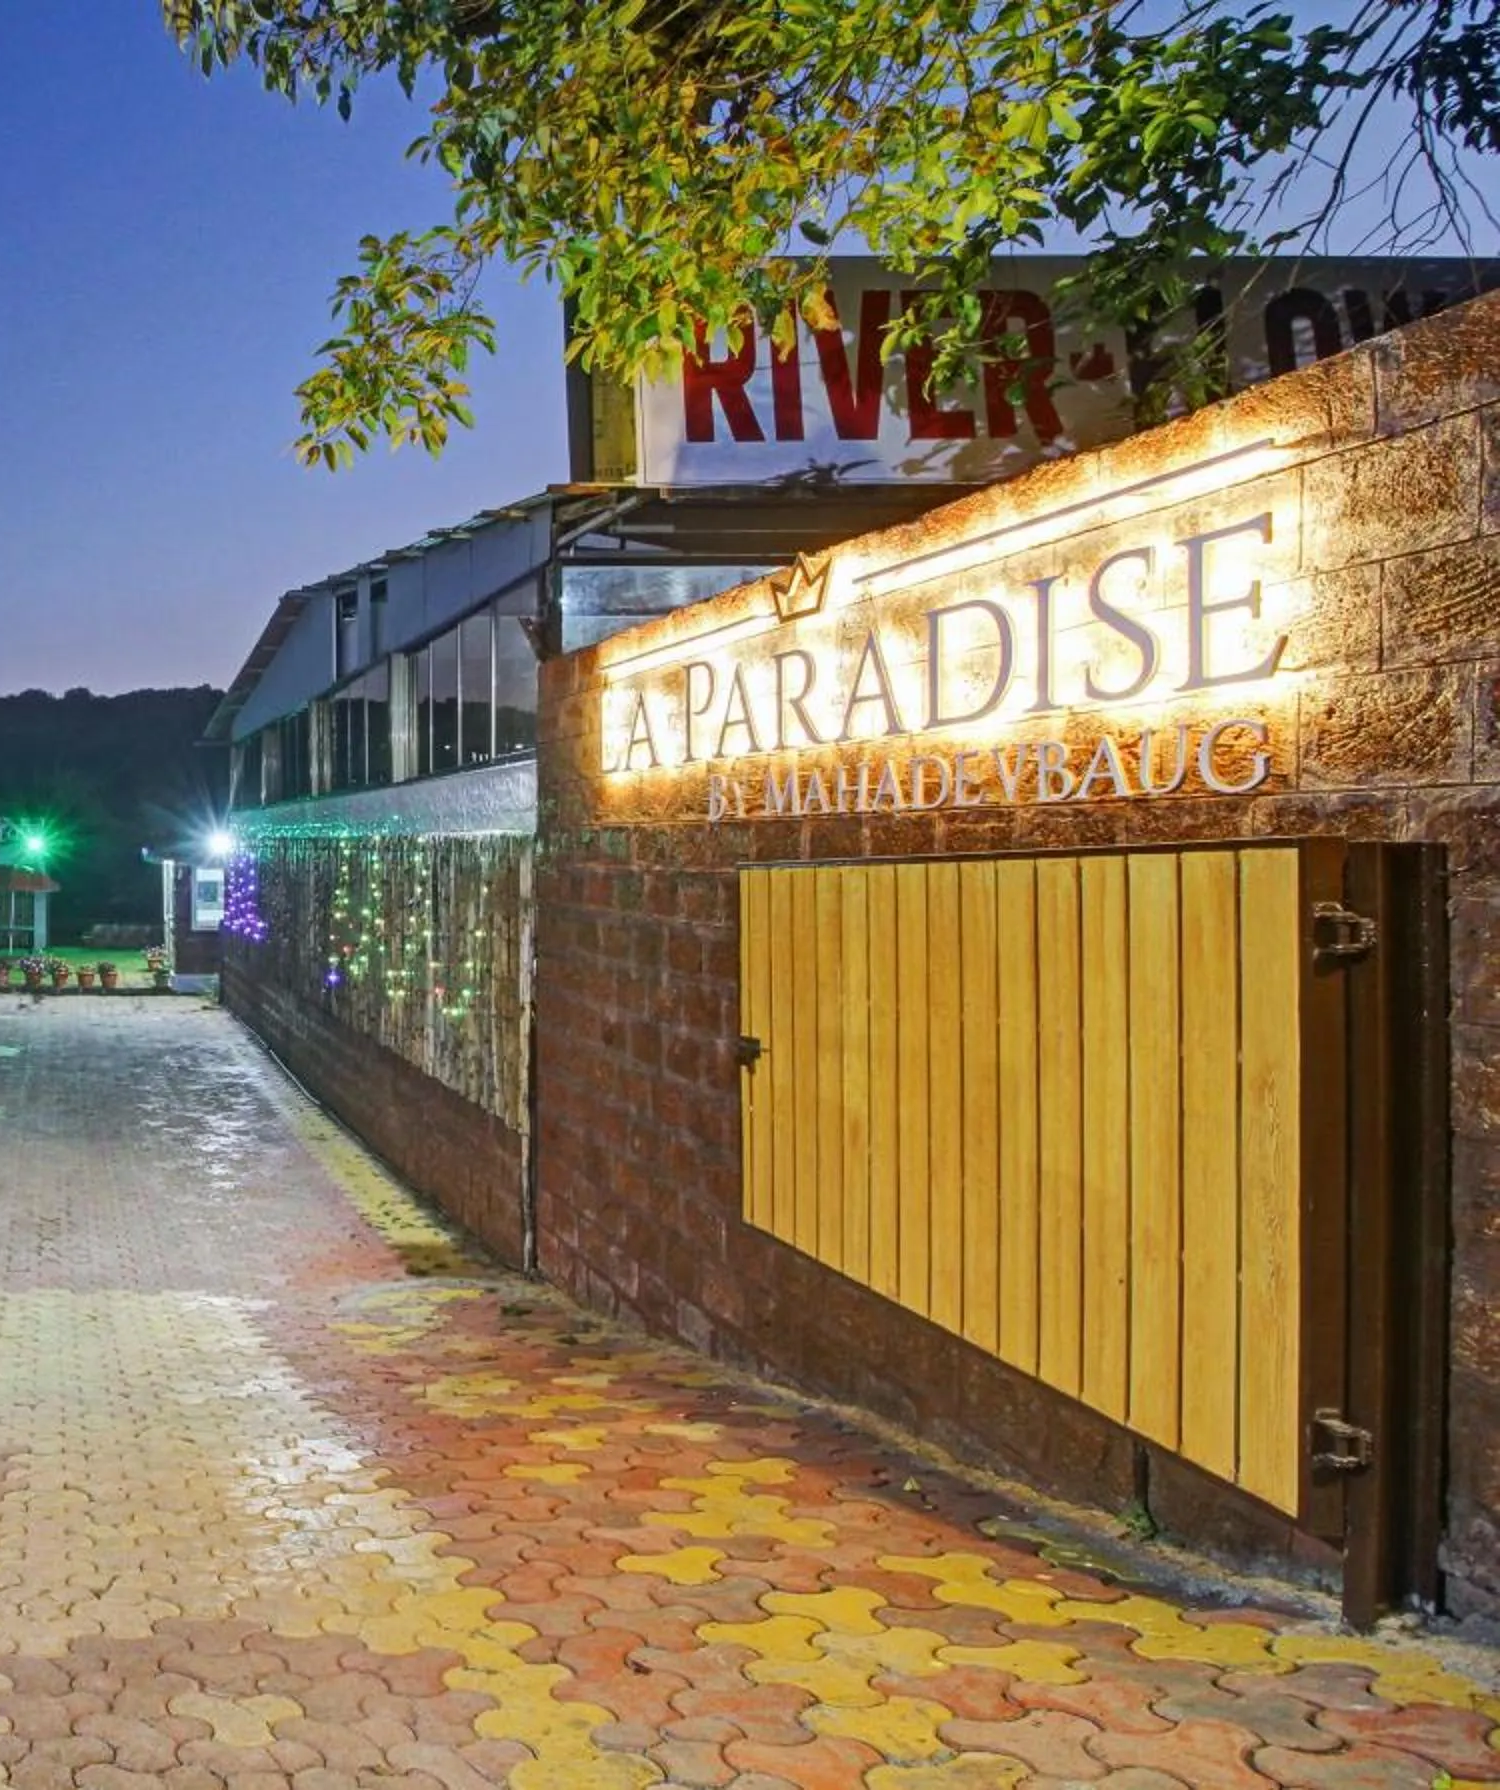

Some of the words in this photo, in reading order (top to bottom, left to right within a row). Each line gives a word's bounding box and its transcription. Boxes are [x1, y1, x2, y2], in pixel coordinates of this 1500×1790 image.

[683, 289, 1064, 444] RIVER
[683, 511, 1289, 763] PARADISE
[709, 774, 746, 822] BY
[765, 718, 1272, 816] MAHADEVBAUG
